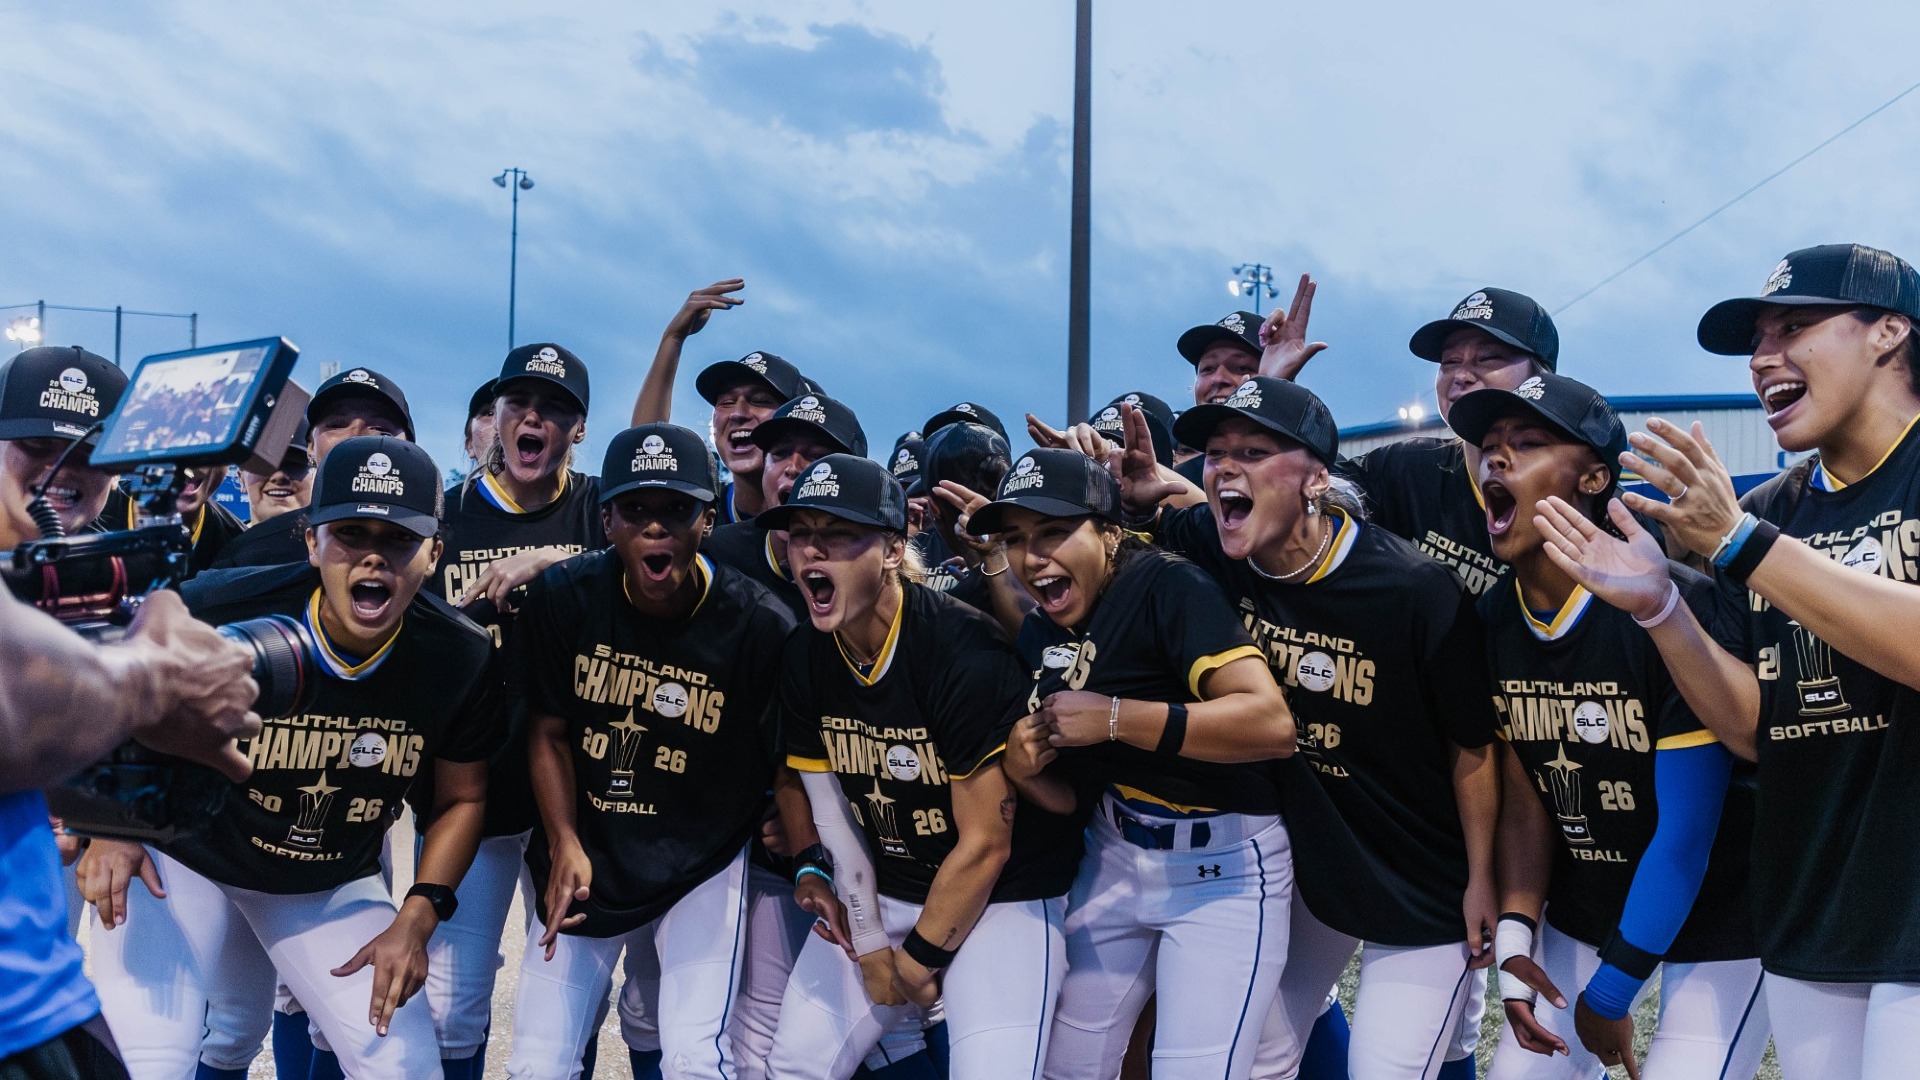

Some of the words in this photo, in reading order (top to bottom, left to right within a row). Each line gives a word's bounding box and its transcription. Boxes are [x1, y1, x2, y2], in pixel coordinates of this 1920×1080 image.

[526, 361, 565, 378] CHAMPS
[49, 388, 94, 400] SOUTHLAND
[40, 391, 99, 417] CHAMPS
[1092, 421, 1124, 431] HAMPS
[631, 459, 677, 472] CHAMPS
[352, 477, 403, 496] CHAMPS
[797, 485, 839, 499] CHAMPS
[1003, 475, 1044, 495] CHAMPS
[460, 544, 583, 561] SOUTND
[1300, 665, 1333, 679] SLC
[655, 694, 686, 707] SLC
[1804, 690, 1839, 702] SLC
[263, 714, 407, 732] UTHLAND
[821, 716, 928, 741] SOUTHLAND
[1492, 695, 1650, 753] CAMPIONS
[1576, 717, 1607, 727] SLC
[1769, 714, 1889, 741] SOFTBALL
[241, 727, 424, 777] HAMPIONS
[351, 746, 383, 756] SLC
[654, 745, 687, 774] 26
[889, 759, 917, 767] SLC
[1598, 780, 1636, 811] 26
[249, 788, 282, 813] 20
[346, 797, 384, 823] 26
[912, 808, 948, 836] 26
[251, 836, 344, 861] SOFTBALL
[1570, 848, 1628, 862] TBALL
